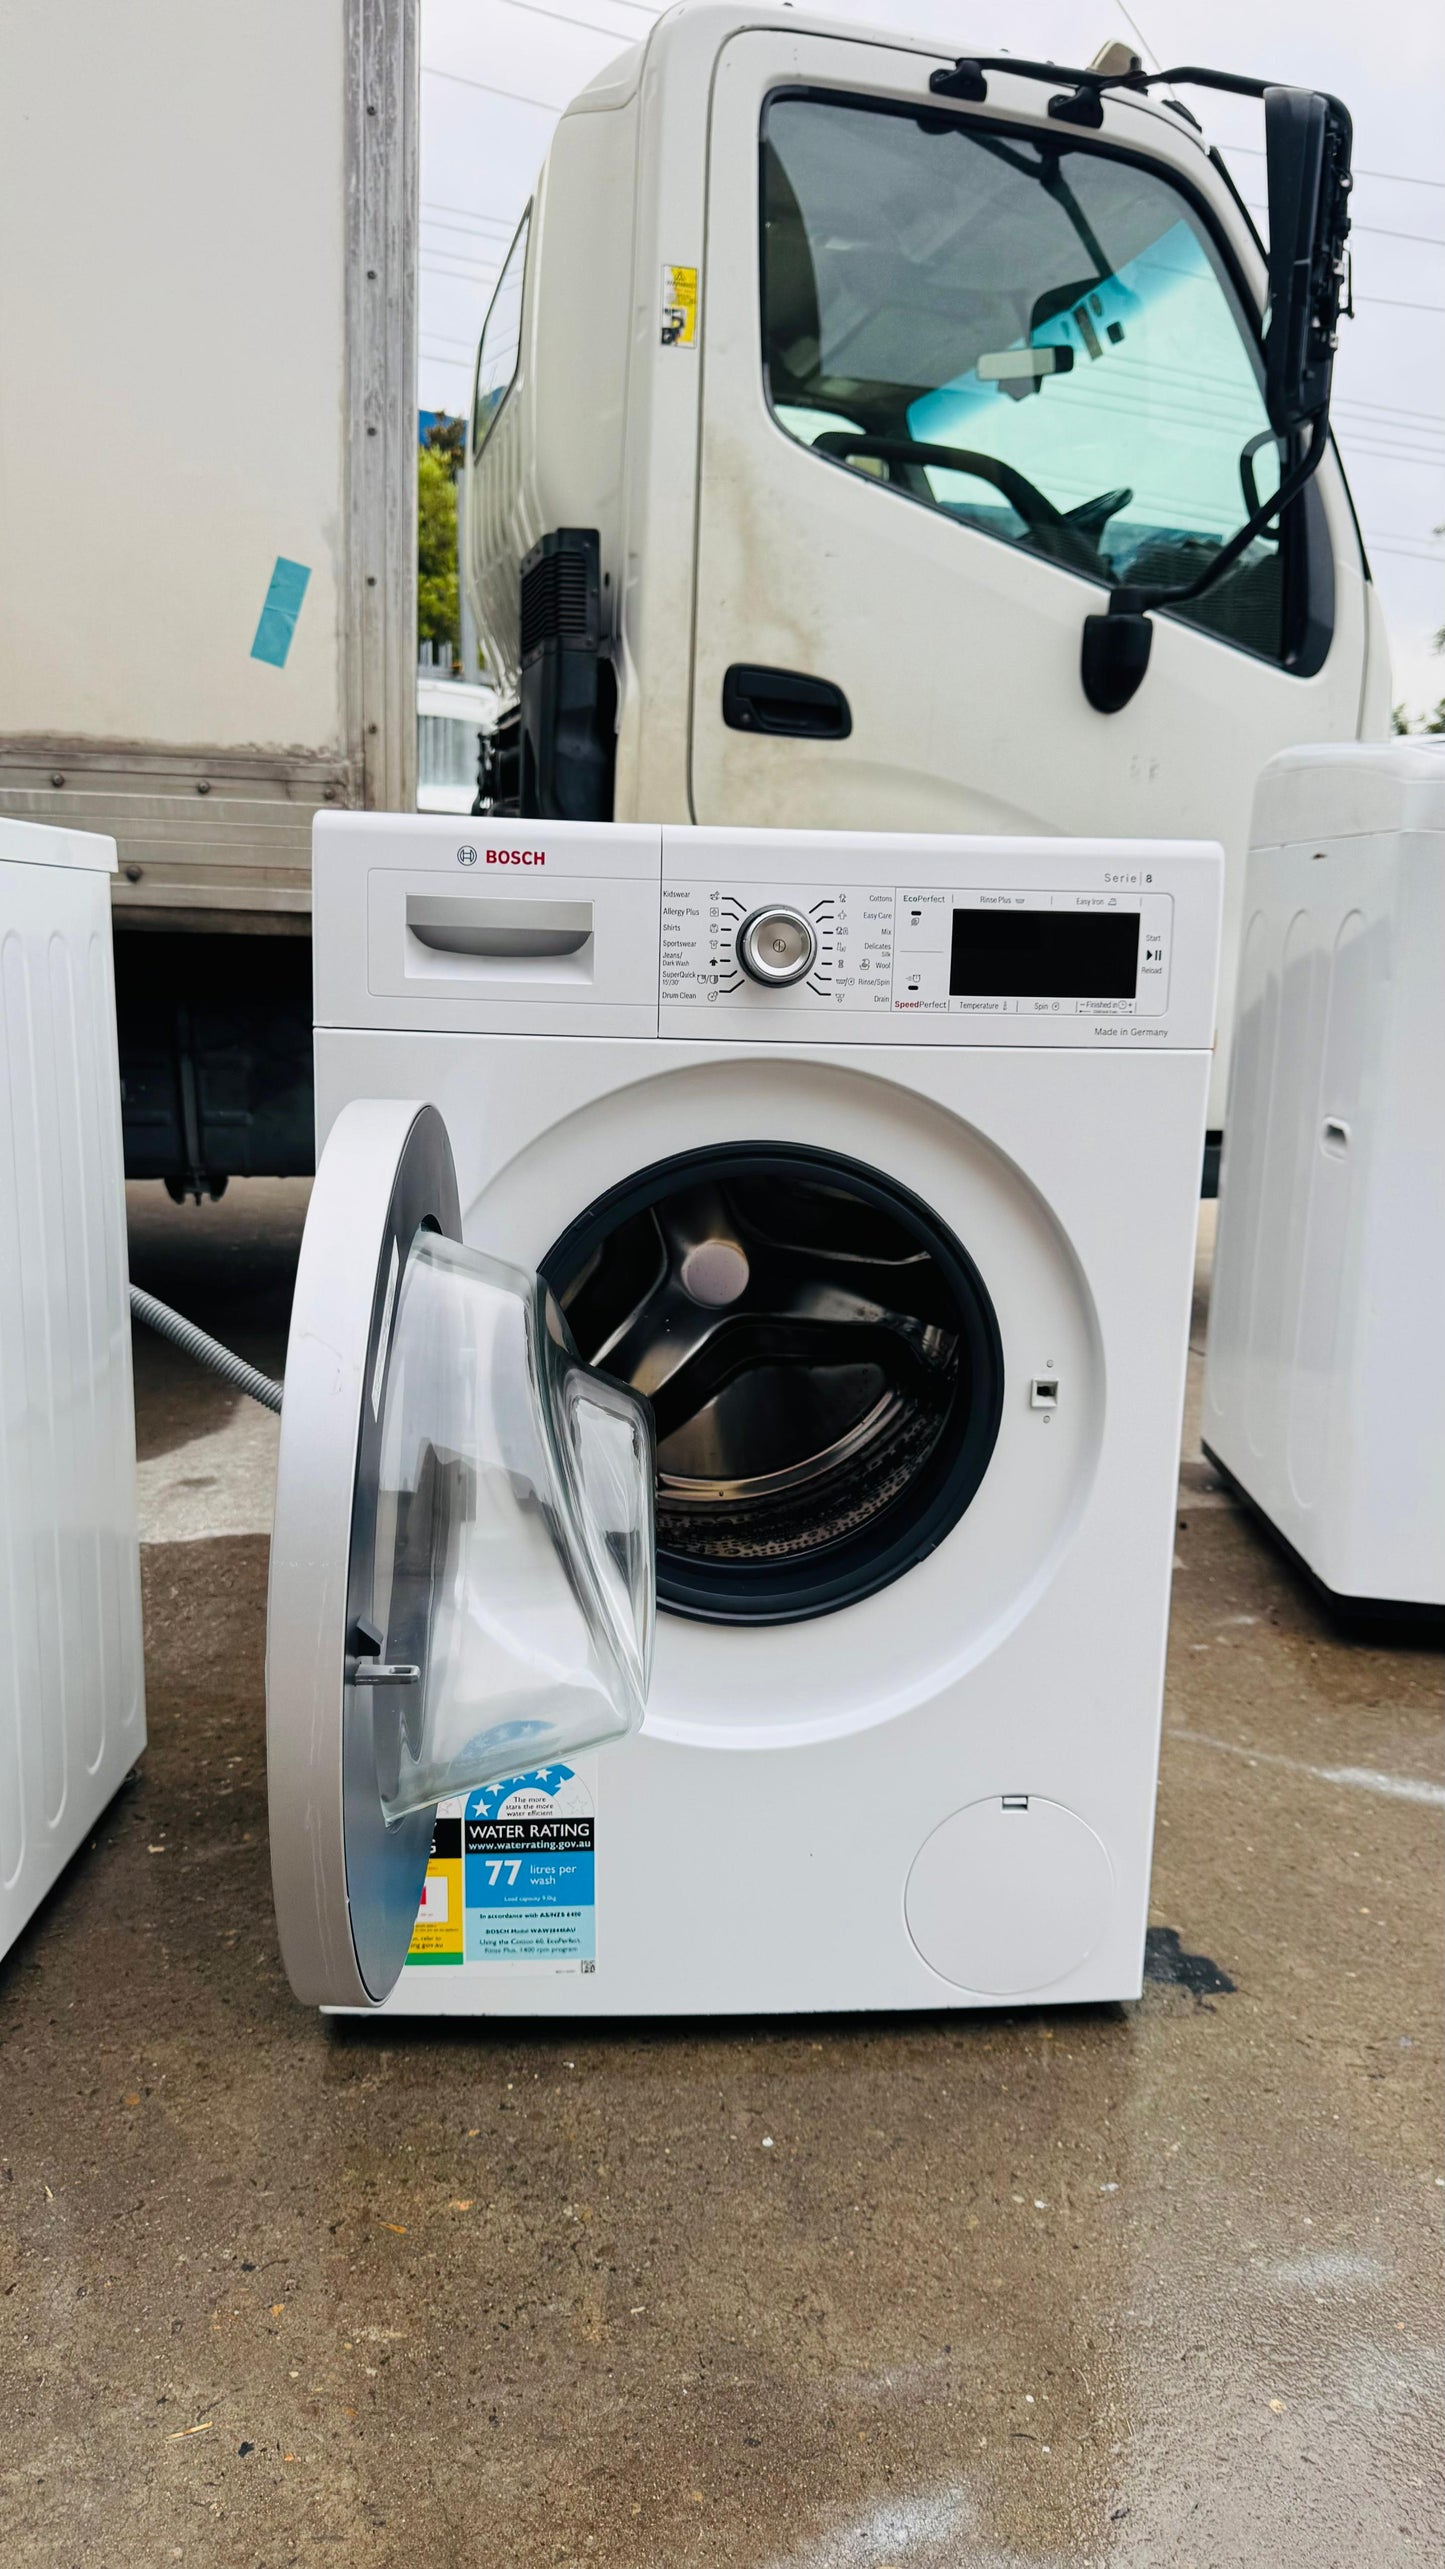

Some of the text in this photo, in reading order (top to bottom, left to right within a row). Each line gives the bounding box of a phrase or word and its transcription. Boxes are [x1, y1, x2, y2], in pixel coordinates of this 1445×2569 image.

[486, 850, 545, 865] BOSCH
[1104, 874, 1153, 883] Serie 8
[903, 895, 945, 903] EcoPerfect
[980, 896, 1012, 904] Rinse Plus
[1076, 898, 1090, 906] Easy
[663, 908, 684, 916] Allergy
[894, 1001, 946, 1009] SpeedPerfect
[960, 1002, 998, 1010] Temperature
[1034, 1002, 1048, 1011] Spin
[1094, 1028, 1168, 1037] Made in Germany
[469, 1824, 590, 1839] WATER RATING
[468, 1840, 591, 1850] www.waterrating.gov.au
[485, 1860, 522, 1886] 77
[530, 1864, 576, 1876] litres per
[530, 1876, 556, 1886] wash
